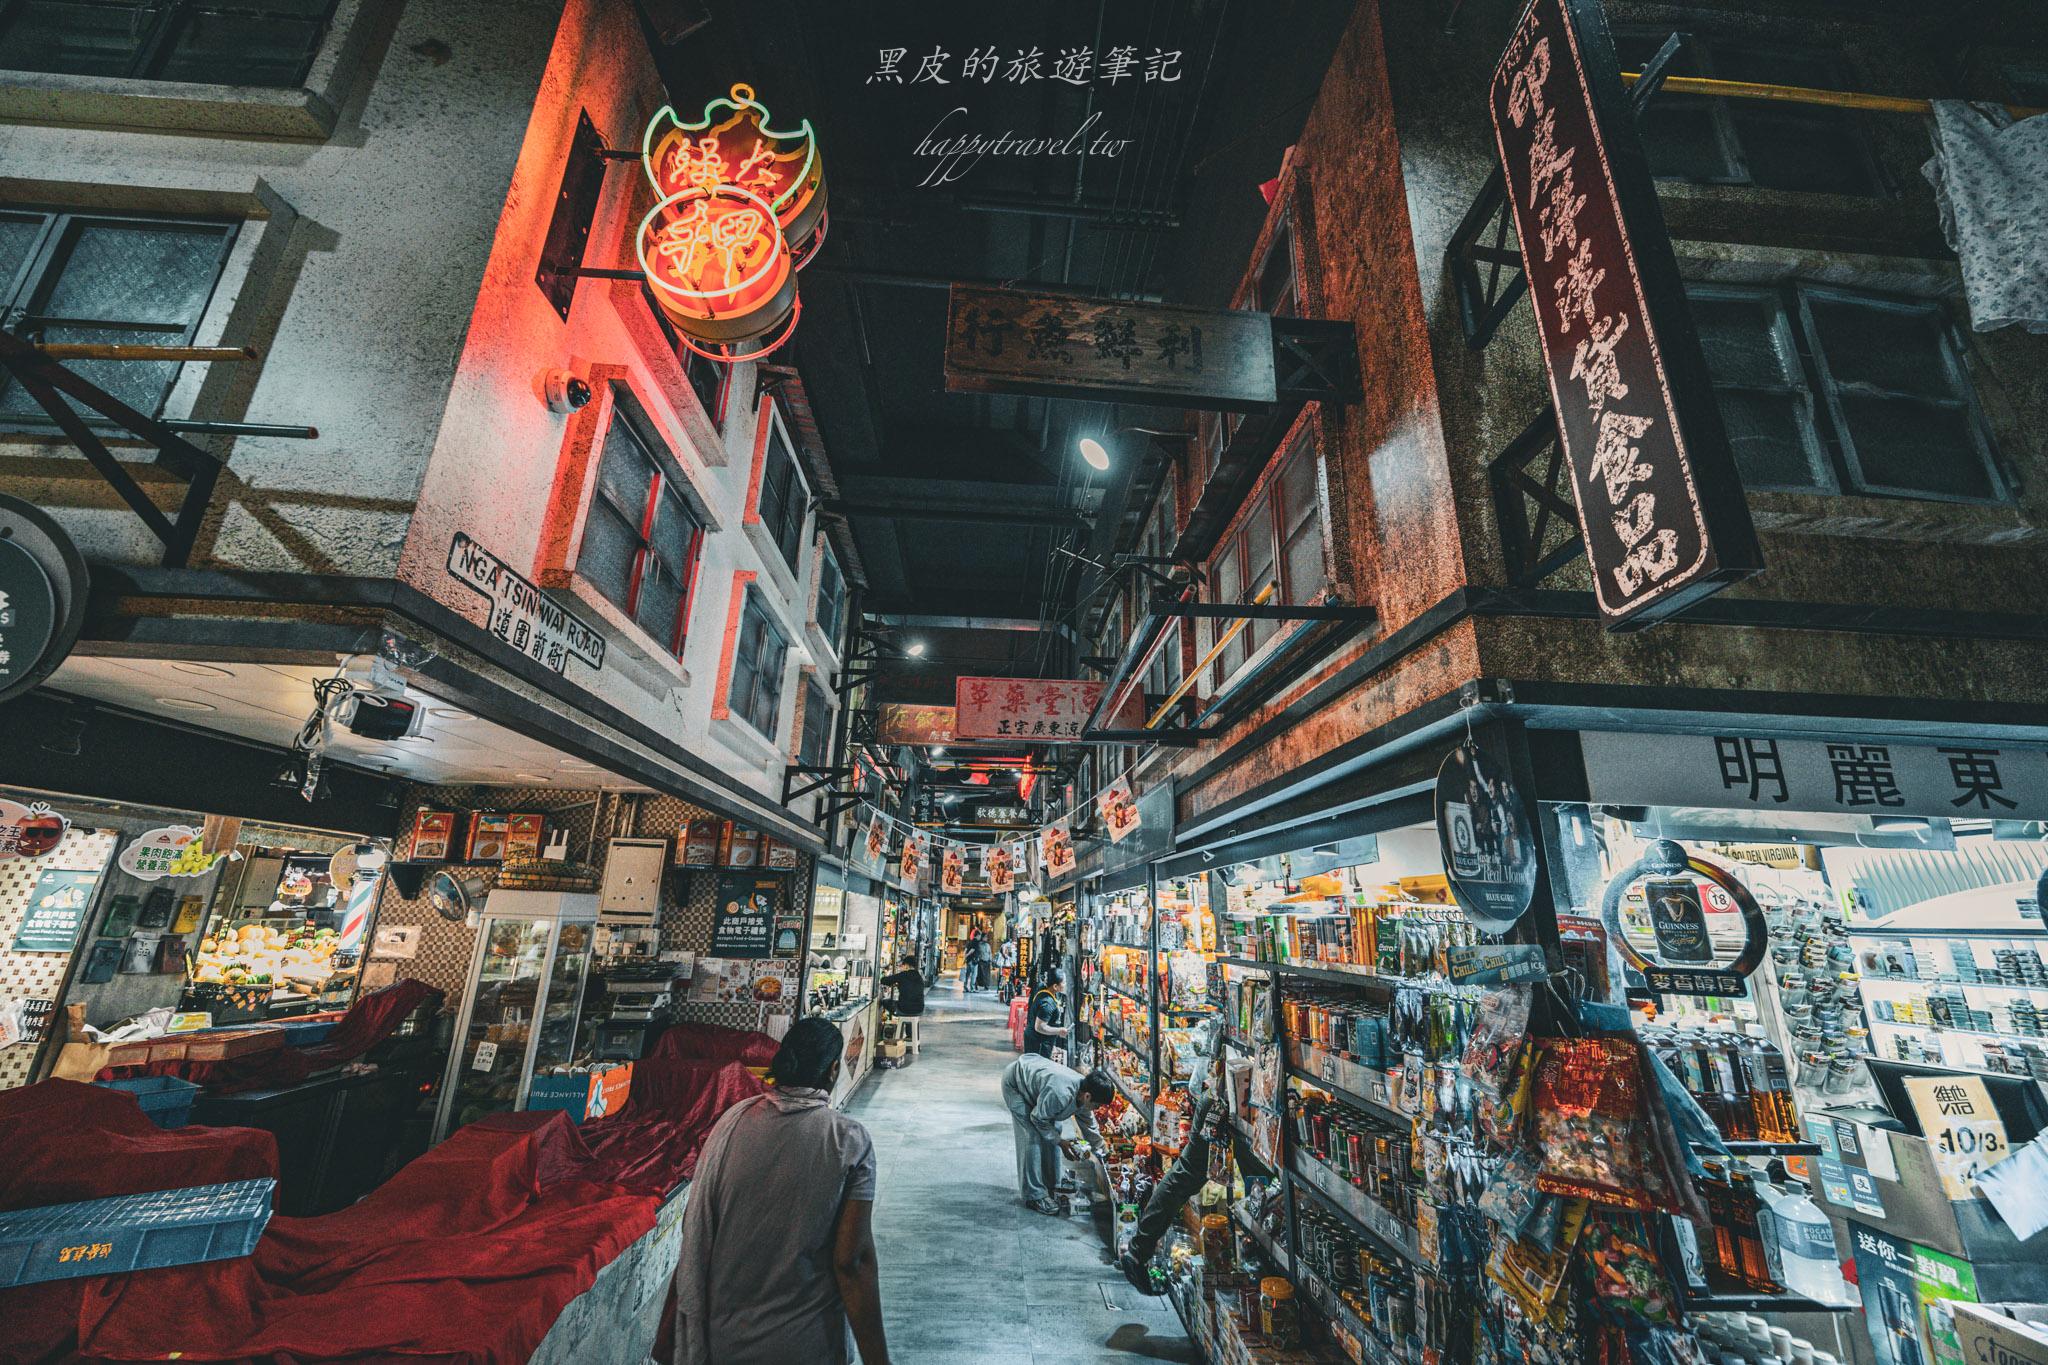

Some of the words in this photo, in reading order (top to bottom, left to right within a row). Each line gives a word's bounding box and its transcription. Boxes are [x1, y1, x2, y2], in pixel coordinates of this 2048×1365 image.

[460, 548, 498, 592] NGA
[504, 575, 539, 617] TSIN
[540, 600, 565, 636] WAI
[566, 624, 600, 660] ROAD
[997, 719, 1082, 738] 正宗廣東涼
[1714, 736, 2048, 811] 明麗東
[139, 846, 184, 859] 果肉飽滿
[1763, 848, 1799, 862] VIRGINIA
[136, 860, 169, 871] 營養高
[1712, 893, 1727, 907] 18
[723, 917, 764, 926] 此商戶接受
[1659, 921, 1700, 931] GUINNESS
[1651, 973, 1740, 993] 麥香醇厚
[551, 1090, 585, 1099] ALLIANCE
[1933, 1085, 1968, 1102] 維他
